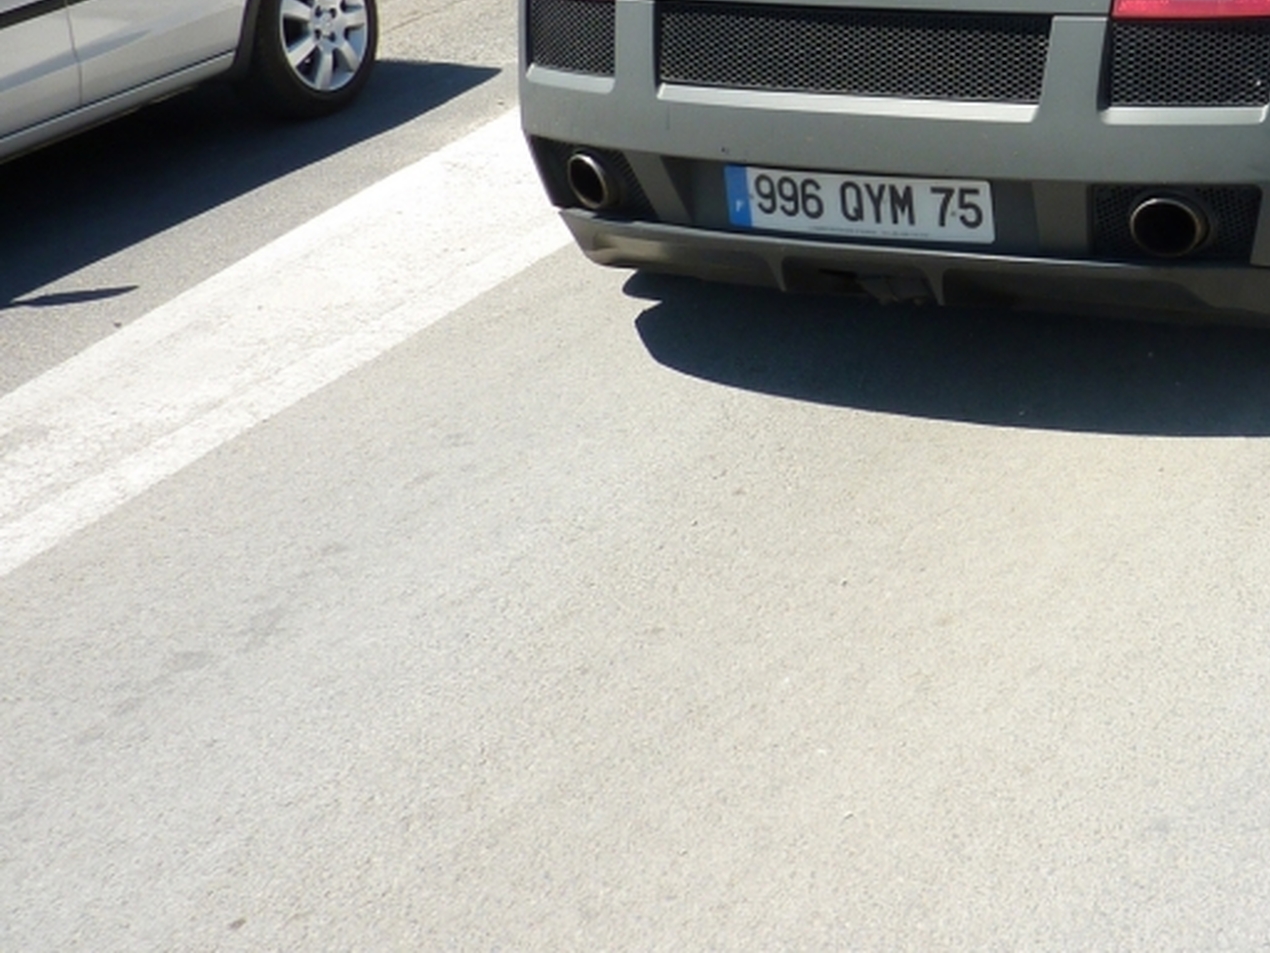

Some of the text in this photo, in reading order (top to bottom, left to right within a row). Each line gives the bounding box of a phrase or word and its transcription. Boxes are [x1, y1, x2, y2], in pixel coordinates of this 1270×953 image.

[754, 174, 984, 228] 996 QYM 75
